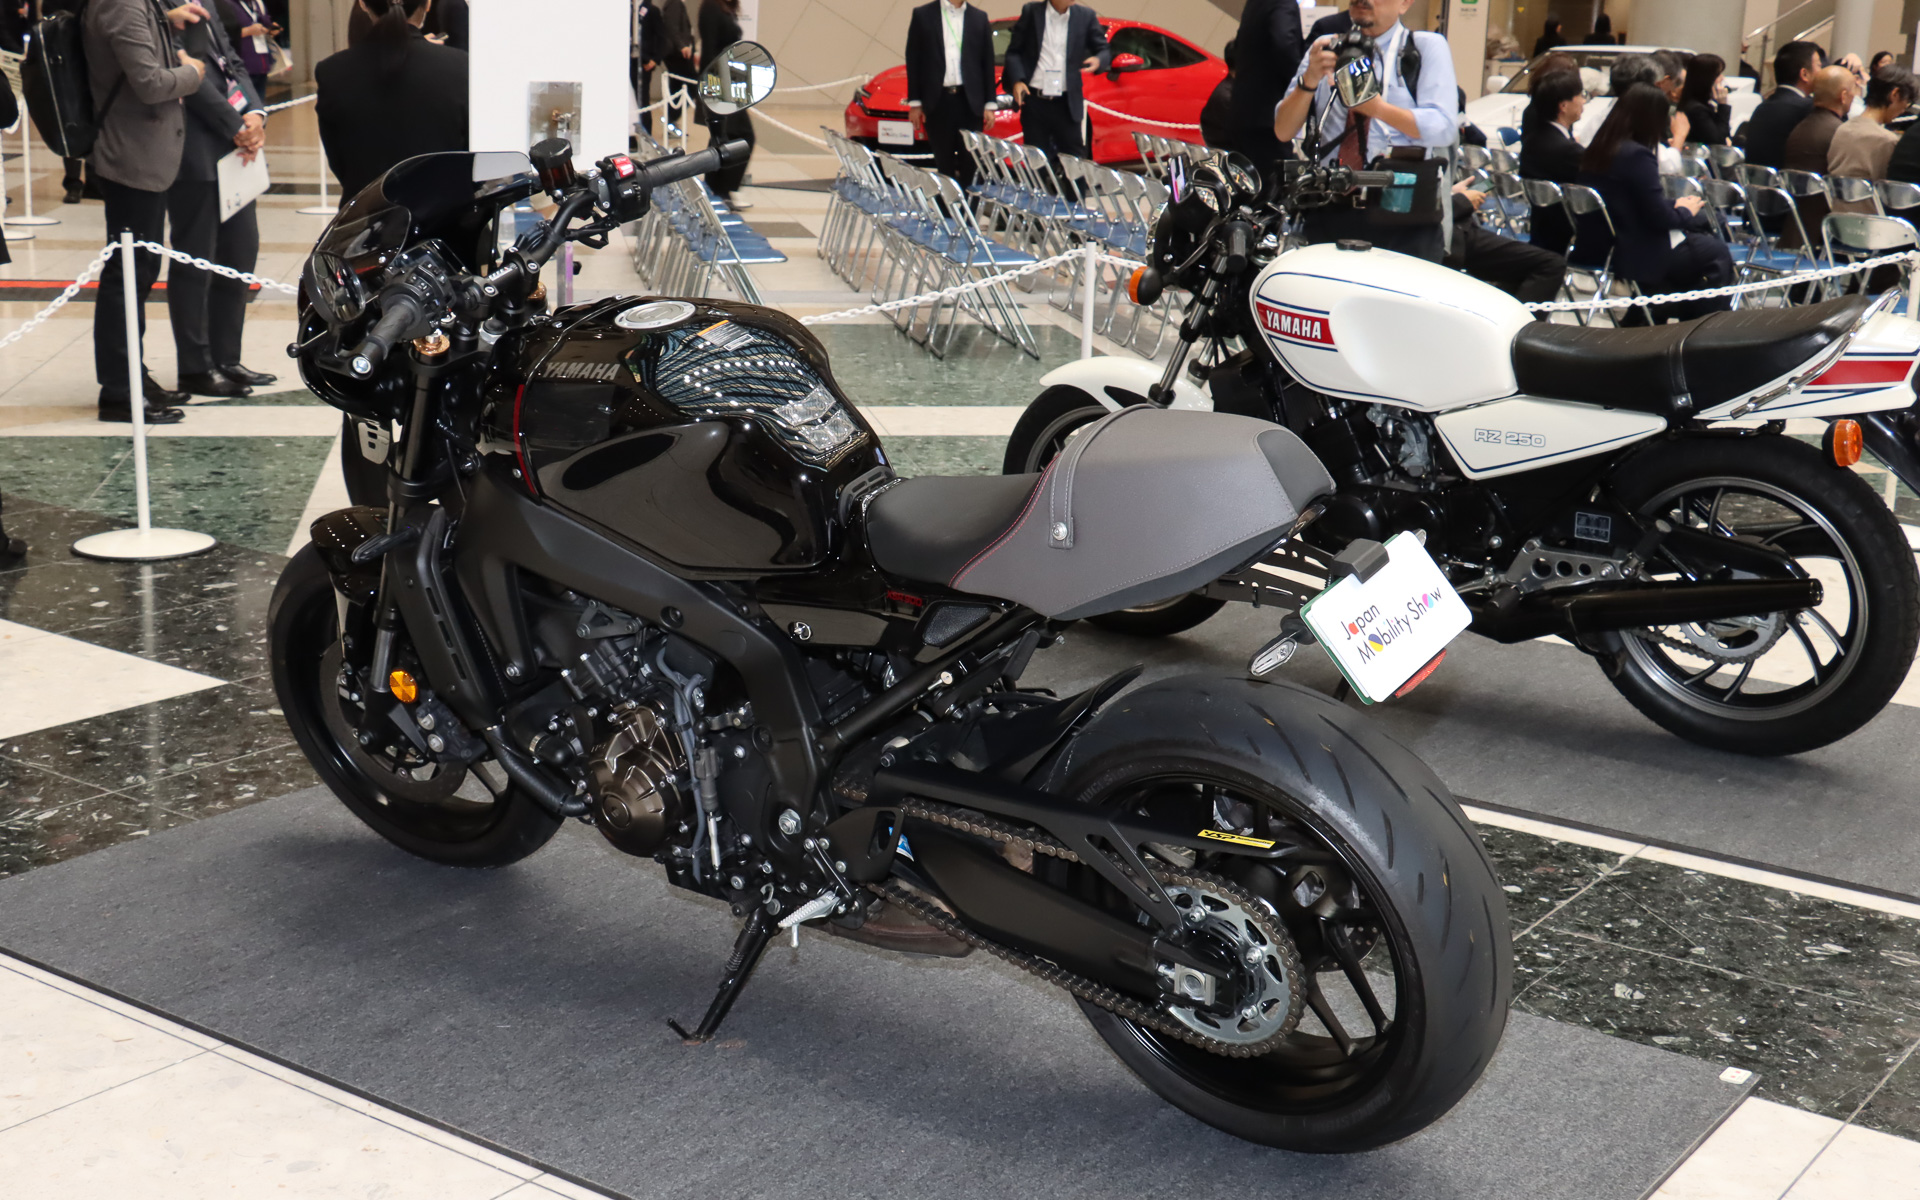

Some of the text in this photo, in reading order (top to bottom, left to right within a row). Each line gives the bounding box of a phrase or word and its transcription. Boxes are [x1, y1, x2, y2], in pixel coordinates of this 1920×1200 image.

[1266, 309, 1321, 339] YAMAHA
[543, 362, 620, 380] YAMAHA
[1474, 428, 1546, 447] RZ 250
[1341, 604, 1380, 640] Japan
[1357, 587, 1442, 664] Mobility Show
